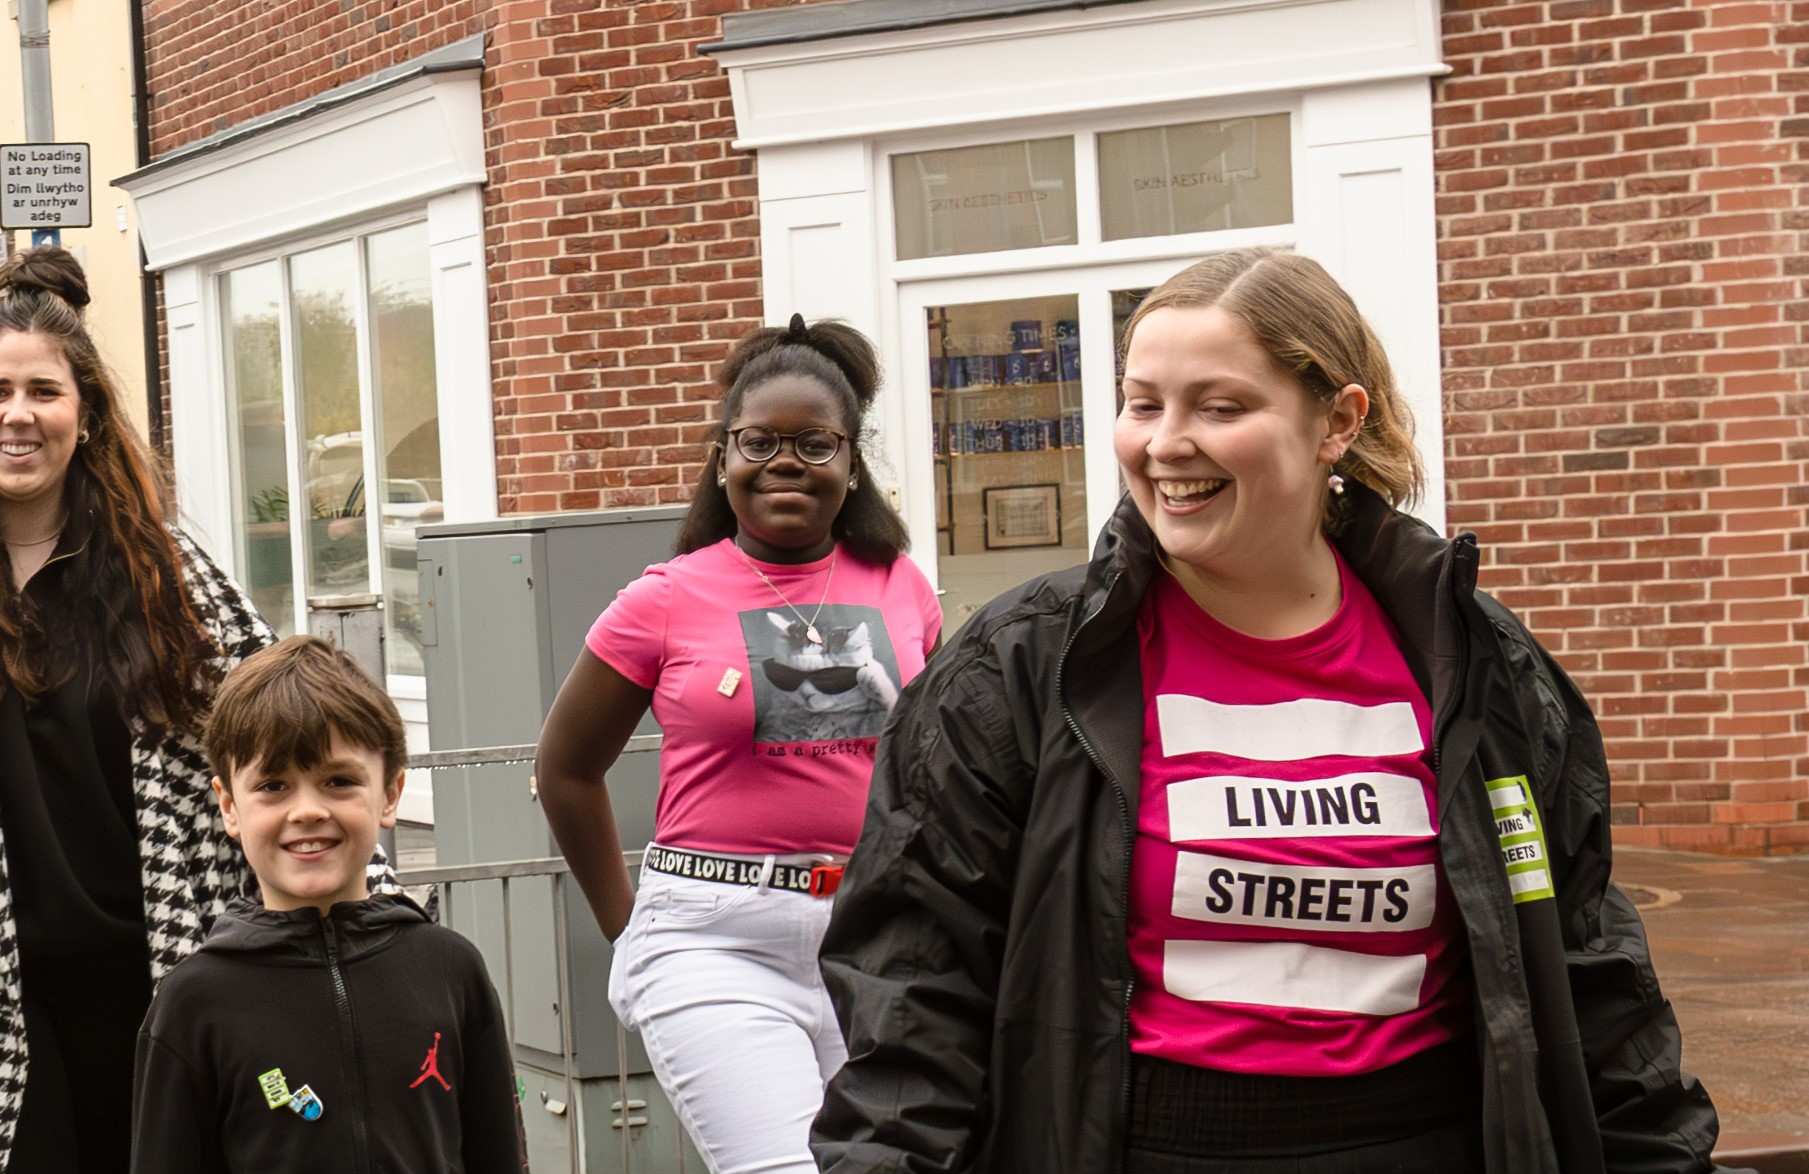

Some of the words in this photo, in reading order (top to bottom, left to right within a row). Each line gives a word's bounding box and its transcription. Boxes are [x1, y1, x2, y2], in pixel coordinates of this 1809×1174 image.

[7, 151, 26, 162] No
[31, 150, 81, 162] Loading
[8, 165, 21, 176] at
[25, 167, 49, 177] any
[53, 164, 81, 175] time
[7, 183, 32, 194] Dim
[36, 182, 85, 195] llwytho
[12, 199, 26, 208] ar
[30, 196, 79, 208] unrhyw
[30, 210, 62, 222] adeg
[767, 746, 787, 757] am
[793, 746, 804, 756] a
[812, 741, 860, 757] pretty
[1225, 782, 1382, 828] LIVING
[659, 850, 693, 876] LOVE
[694, 857, 736, 881] LOVE
[738, 863, 785, 887] LOE
[1205, 868, 1410, 924] STREETS
